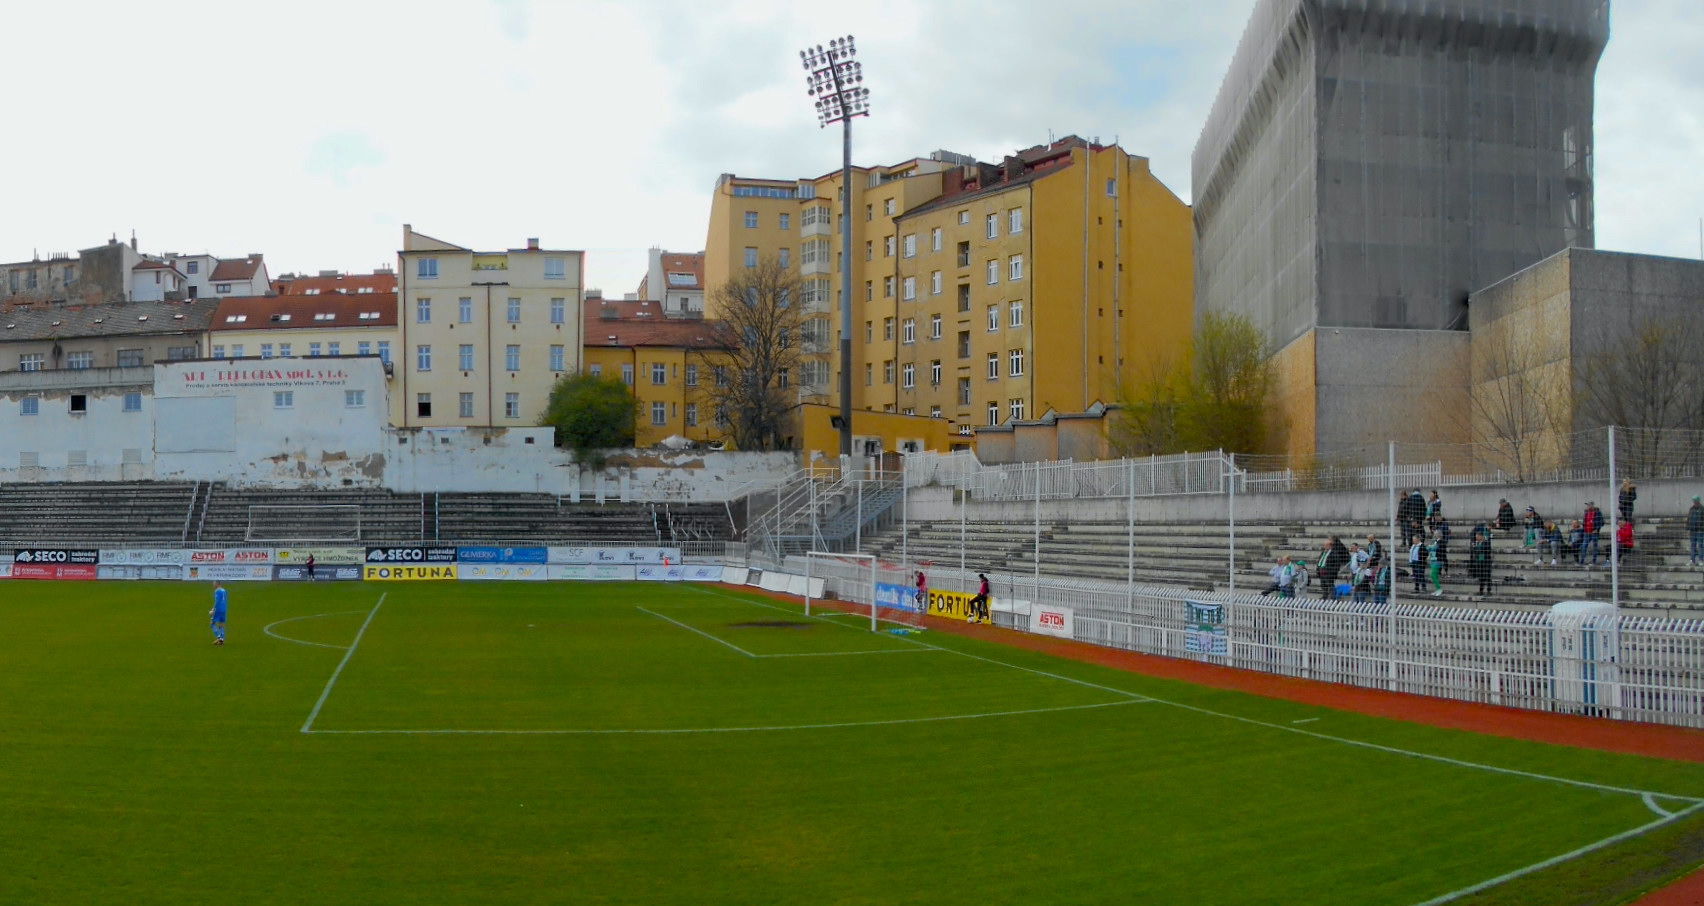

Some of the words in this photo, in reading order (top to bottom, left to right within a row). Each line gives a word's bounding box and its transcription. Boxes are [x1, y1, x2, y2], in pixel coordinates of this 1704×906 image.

[34, 550, 67, 562] SECO
[191, 551, 225, 560] ASTON
[234, 551, 269, 559] ASTON
[387, 549, 423, 561] SECO
[367, 567, 454, 578] FORTUNA
[929, 592, 990, 621] FORTUA
[1039, 613, 1065, 626] ASTON
